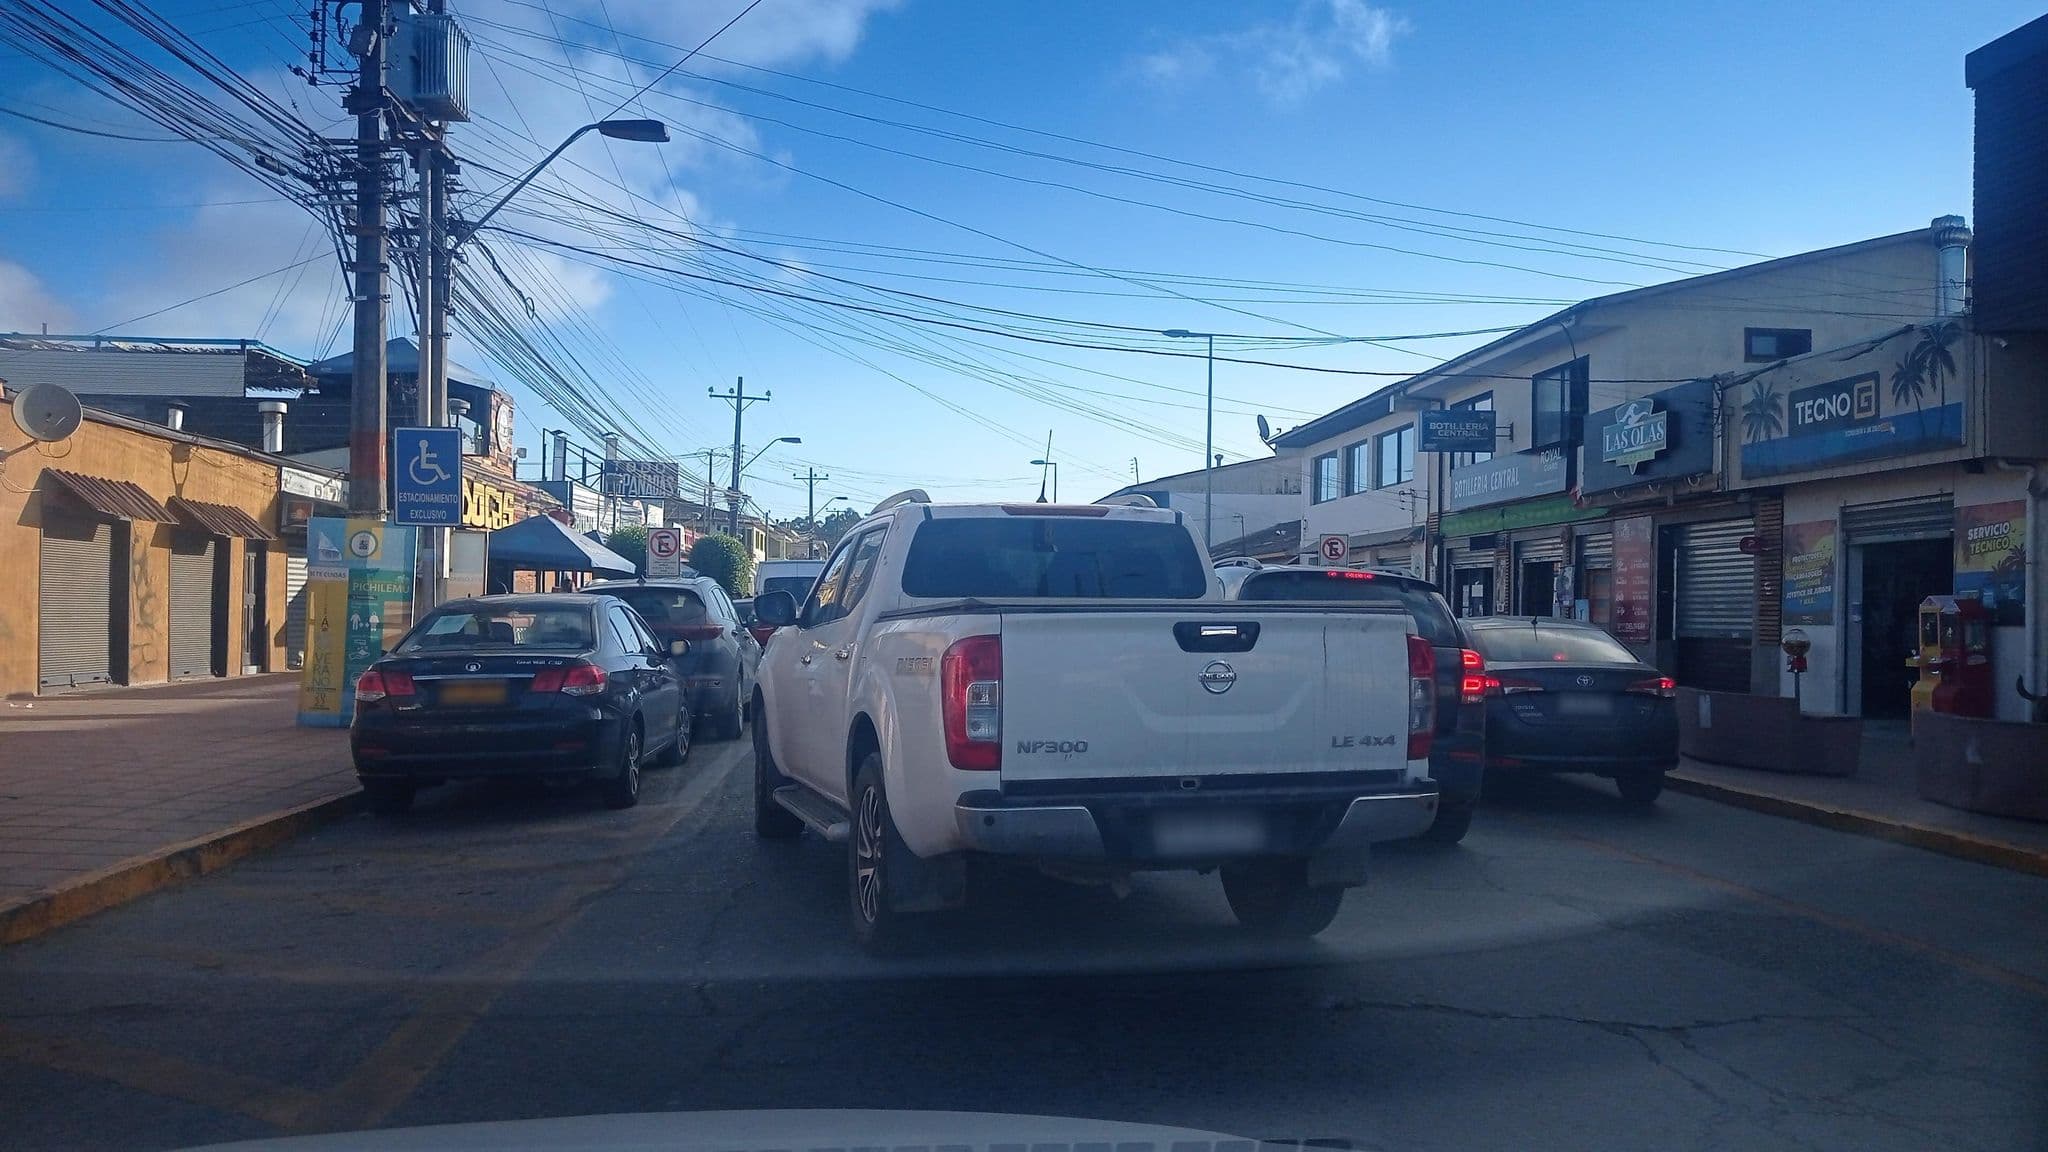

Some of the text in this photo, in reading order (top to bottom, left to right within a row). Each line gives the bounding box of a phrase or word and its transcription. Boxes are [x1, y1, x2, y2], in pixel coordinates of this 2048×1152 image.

[1795, 392, 1851, 425] TECNO
[1429, 422, 1489, 430] BOTILLERIA
[1438, 429, 1481, 437] CENTRAL
[1605, 422, 1664, 452] LAS OLAS
[1540, 447, 1562, 465] ROYAL
[1454, 467, 1520, 499] BOTILLERIA CENTRAL
[399, 492, 457, 504] ESTACIONAMIENTO
[410, 509, 447, 520] EXCLUSIVO
[1967, 522, 2010, 541] SERVICIO
[352, 582, 409, 594] PICHILEMU
[1017, 741, 1088, 754] NP300
[1331, 736, 1354, 748] LE
